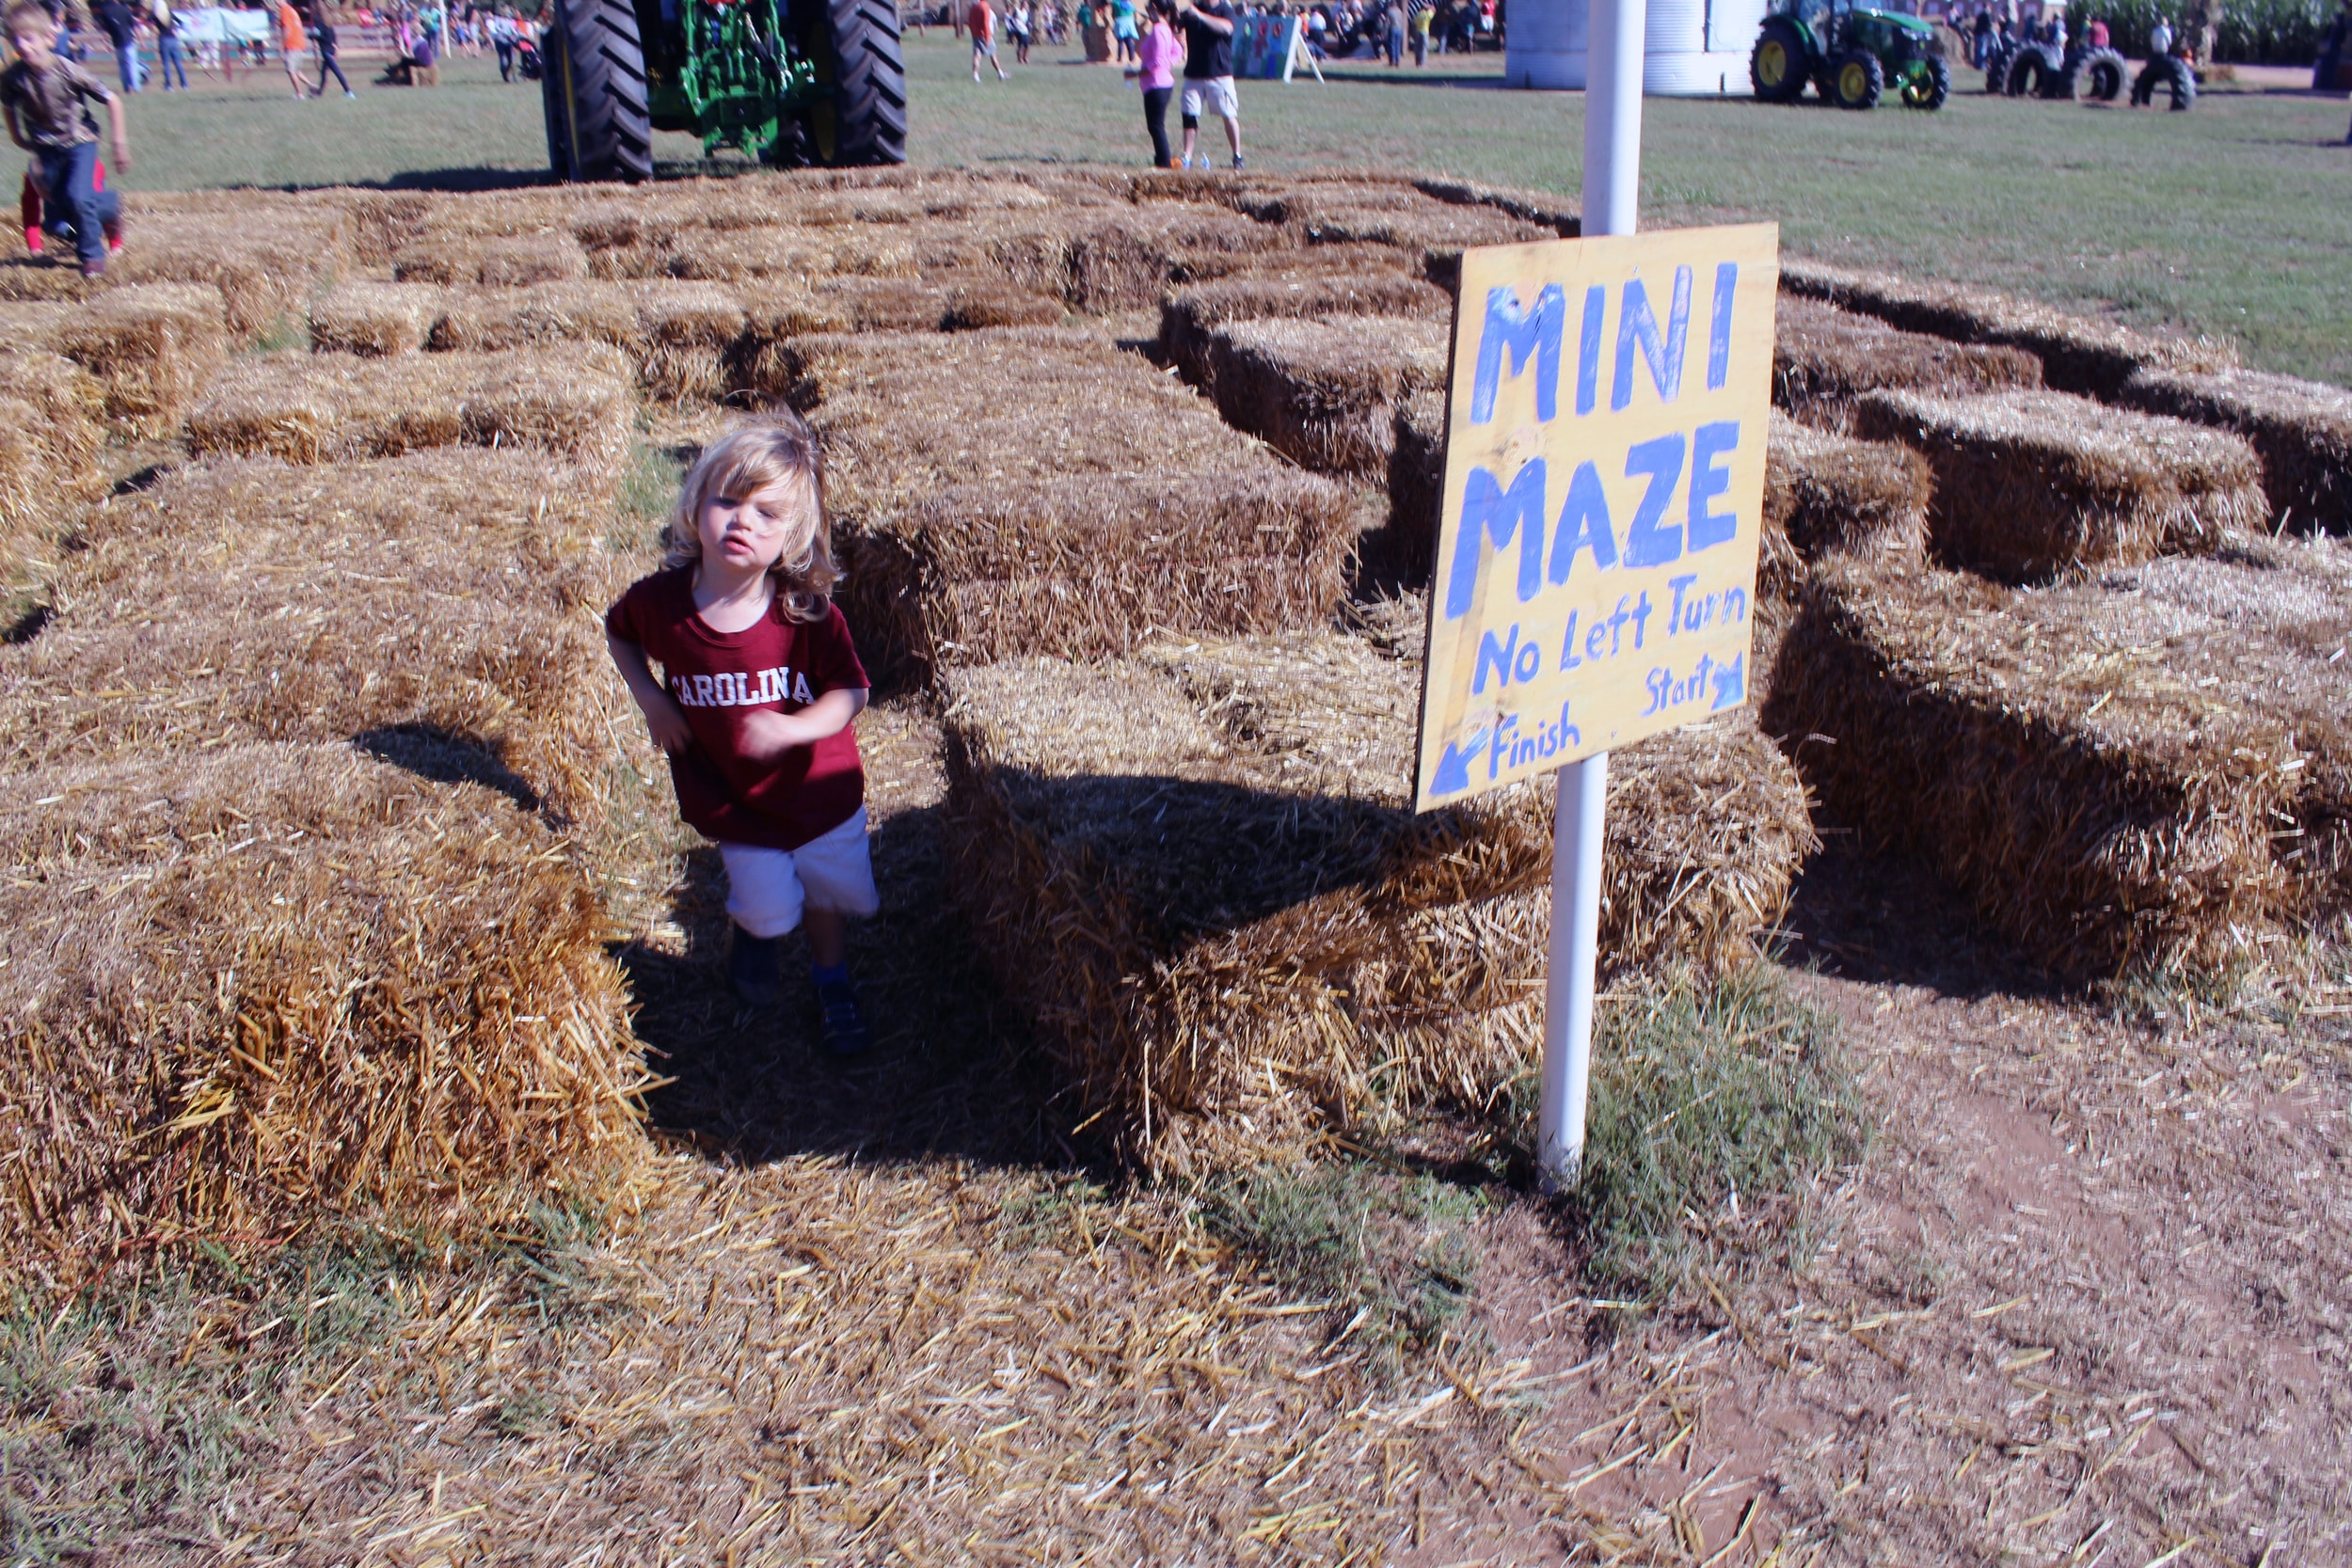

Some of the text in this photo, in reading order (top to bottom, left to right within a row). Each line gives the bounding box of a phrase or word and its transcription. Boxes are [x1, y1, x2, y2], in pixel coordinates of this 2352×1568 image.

[1470, 261, 1739, 424] MINI
[1445, 420, 1741, 621] MAZE
[1471, 574, 1746, 696] No Left Turn
[1641, 651, 1714, 718] Start
[671, 666, 817, 706] CAROLINA
[1487, 701, 1581, 781] Finish
